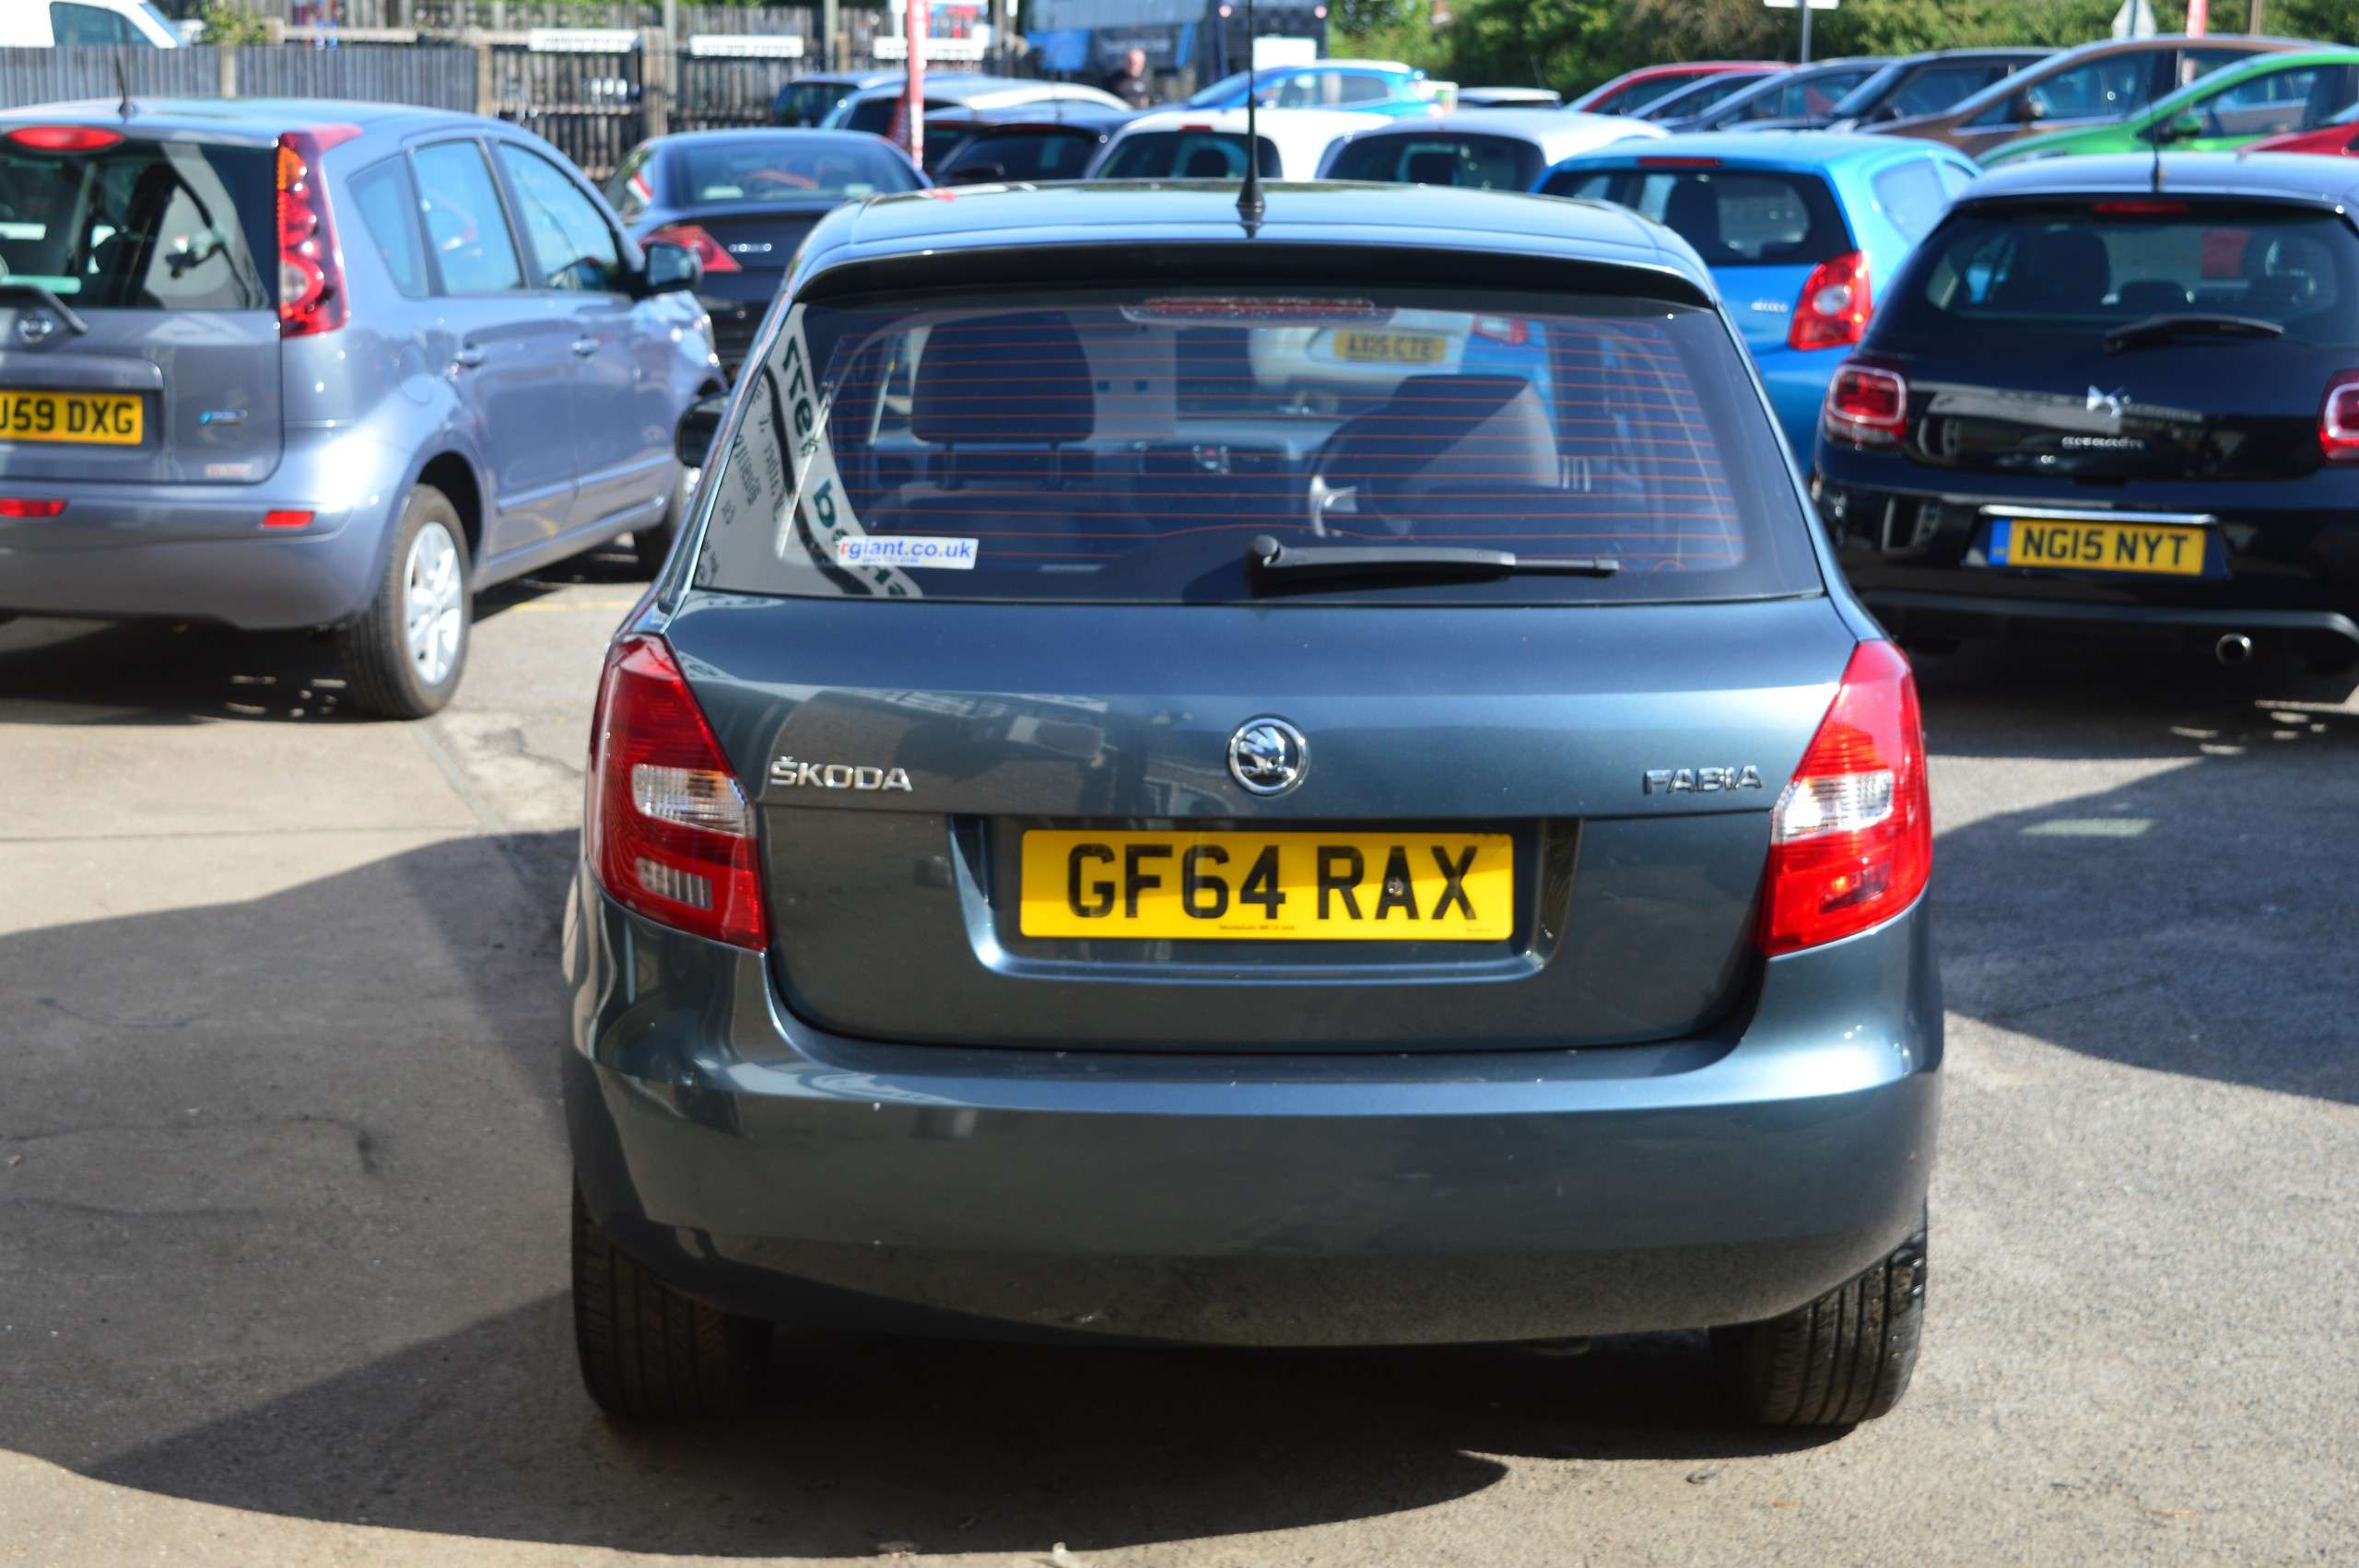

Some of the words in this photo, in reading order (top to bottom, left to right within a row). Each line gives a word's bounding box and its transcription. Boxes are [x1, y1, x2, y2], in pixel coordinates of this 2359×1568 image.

[67, 399, 134, 435] DXG
[840, 538, 972, 560] rgiant.co.uk
[2023, 526, 2104, 561] NG15
[2116, 531, 2189, 568] NYT
[769, 755, 913, 792] ŠKODA
[1642, 765, 1763, 795] FABIA
[1067, 843, 1286, 920] GF64
[1316, 845, 1479, 920] RAX
